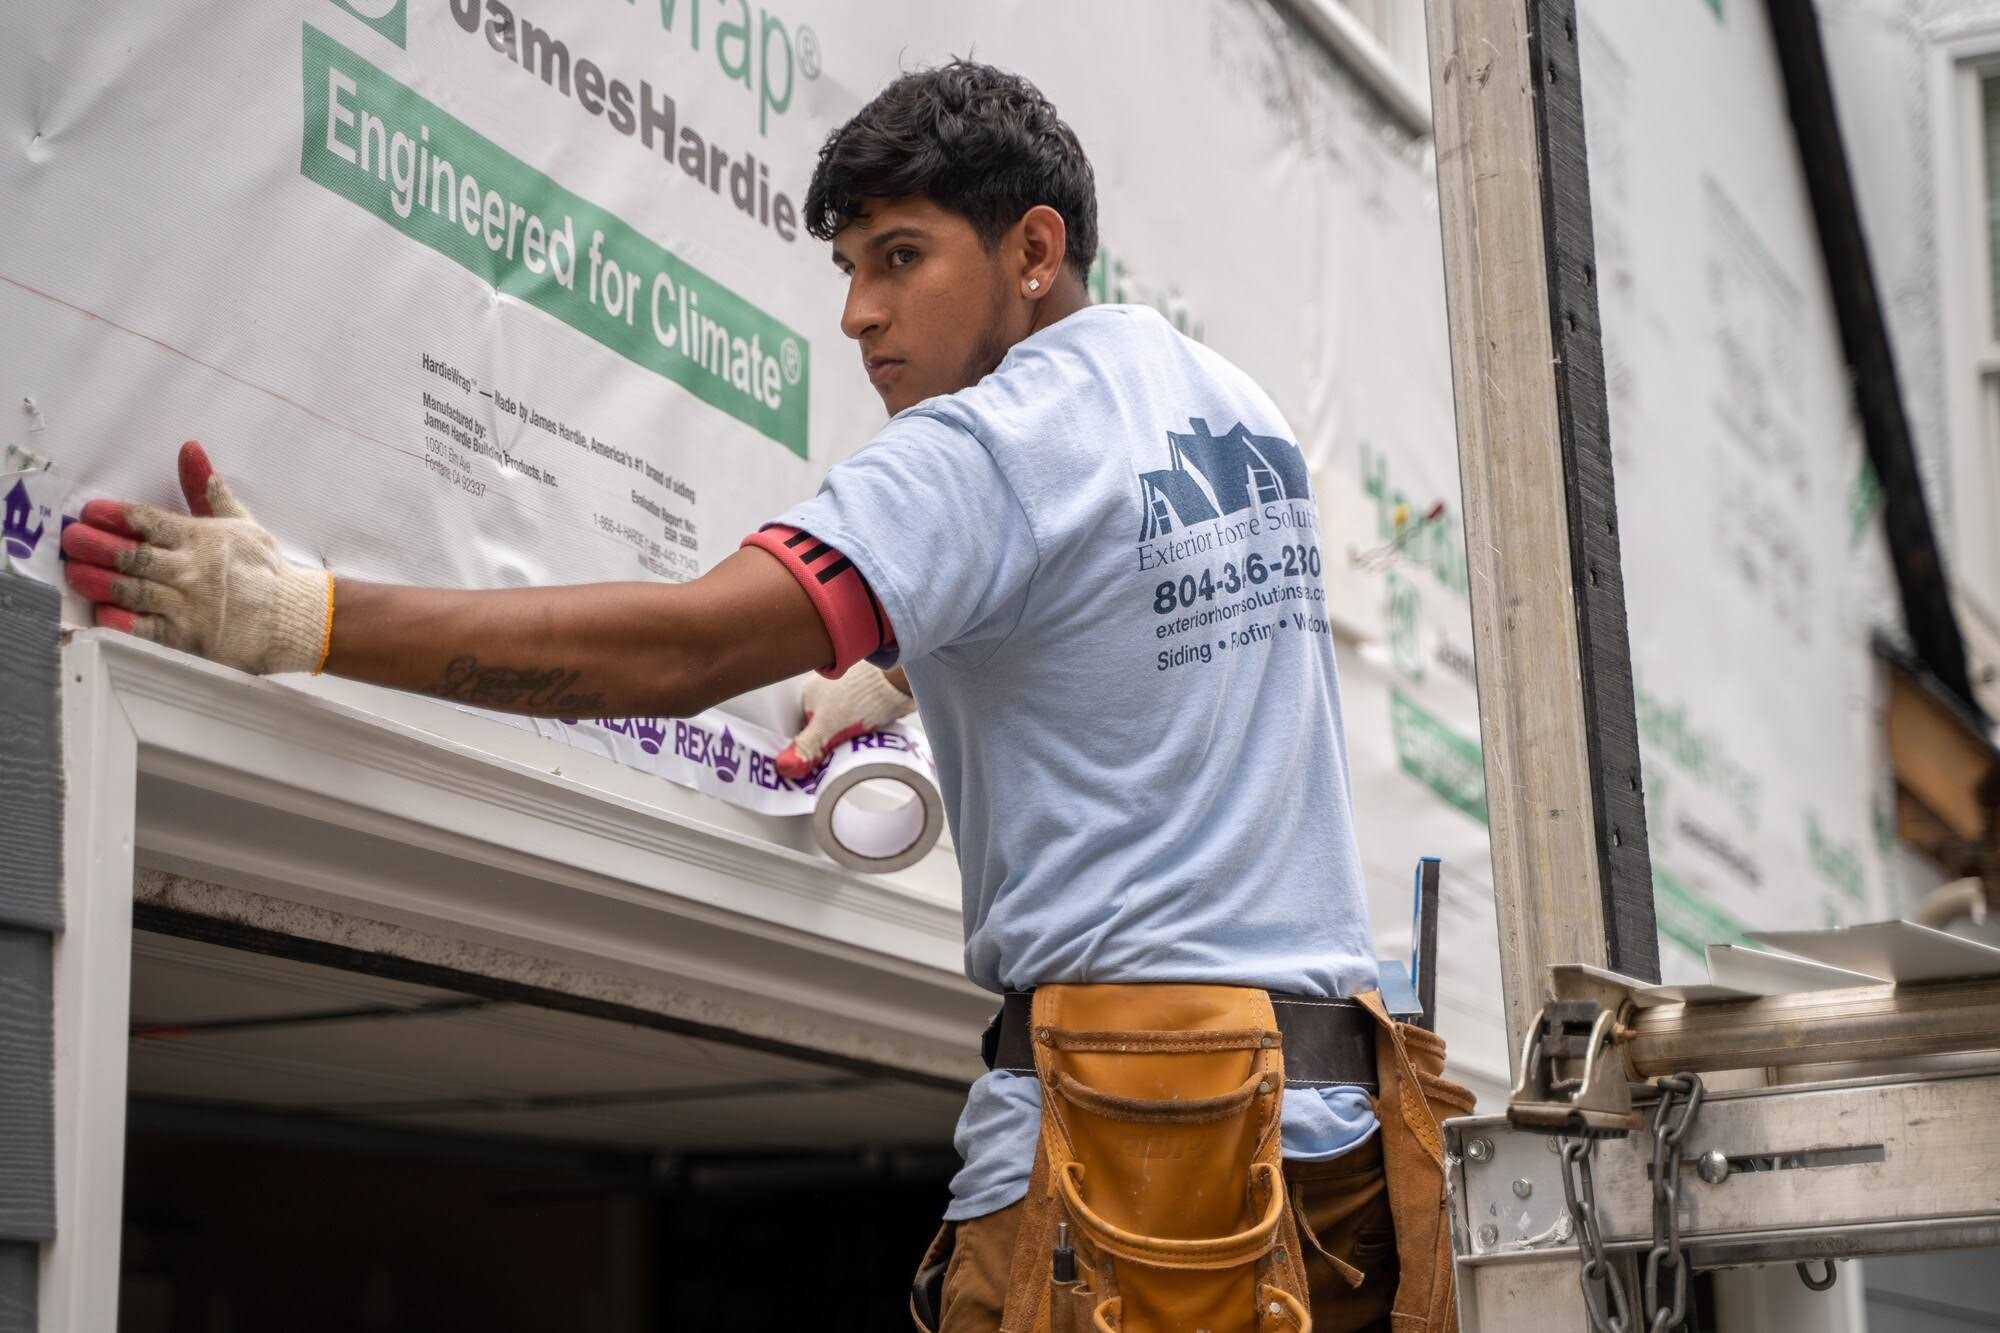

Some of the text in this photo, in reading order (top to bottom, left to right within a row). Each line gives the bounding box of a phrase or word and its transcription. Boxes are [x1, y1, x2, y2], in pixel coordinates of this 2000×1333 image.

[326, 66, 575, 292] Engineered
[588, 229, 641, 326] for
[422, 391, 487, 439] Manufactured by:
[494, 389, 517, 415] Made
[519, 401, 529, 424] by
[528, 409, 558, 435] James
[424, 412, 450, 435] James
[451, 424, 472, 449] Hardie
[504, 452, 542, 482] Products,
[543, 470, 559, 488] Inc.
[1136, 530, 1213, 573] Exterior
[1152, 543, 1322, 616] 804-36-230
[1157, 641, 1212, 672] Siding
[675, 719, 713, 768] REX
[852, 731, 922, 760] REX
